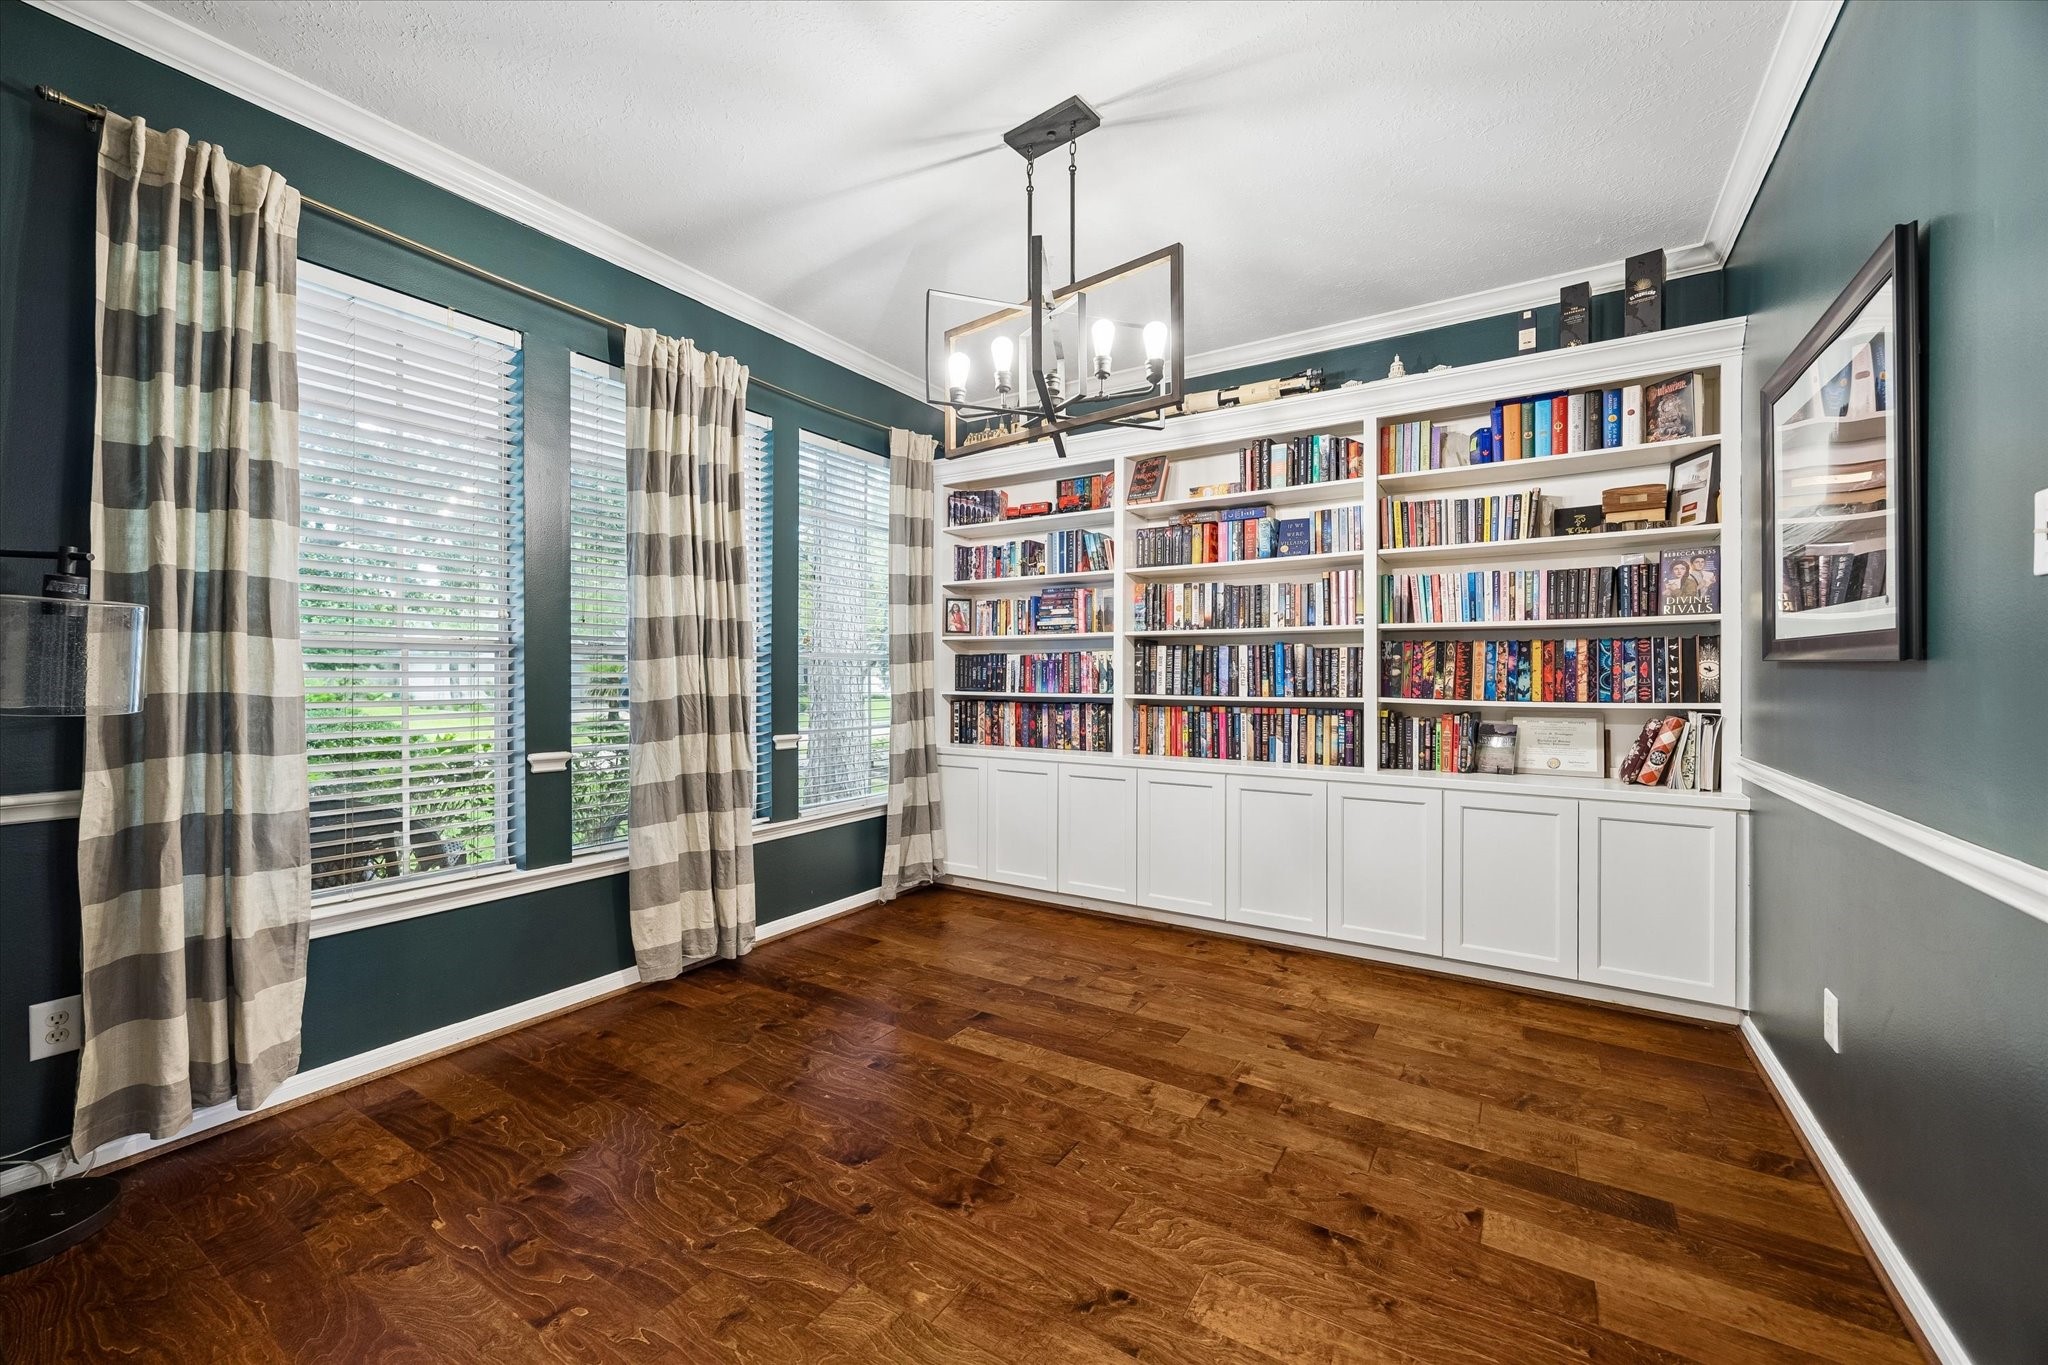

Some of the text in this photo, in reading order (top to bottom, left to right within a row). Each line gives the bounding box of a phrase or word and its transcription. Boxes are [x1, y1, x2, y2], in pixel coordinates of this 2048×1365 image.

[1664, 550, 1695, 558] REBECCA
[1666, 595, 1711, 605] DIVINE
[1663, 603, 1713, 615] RIVALS
